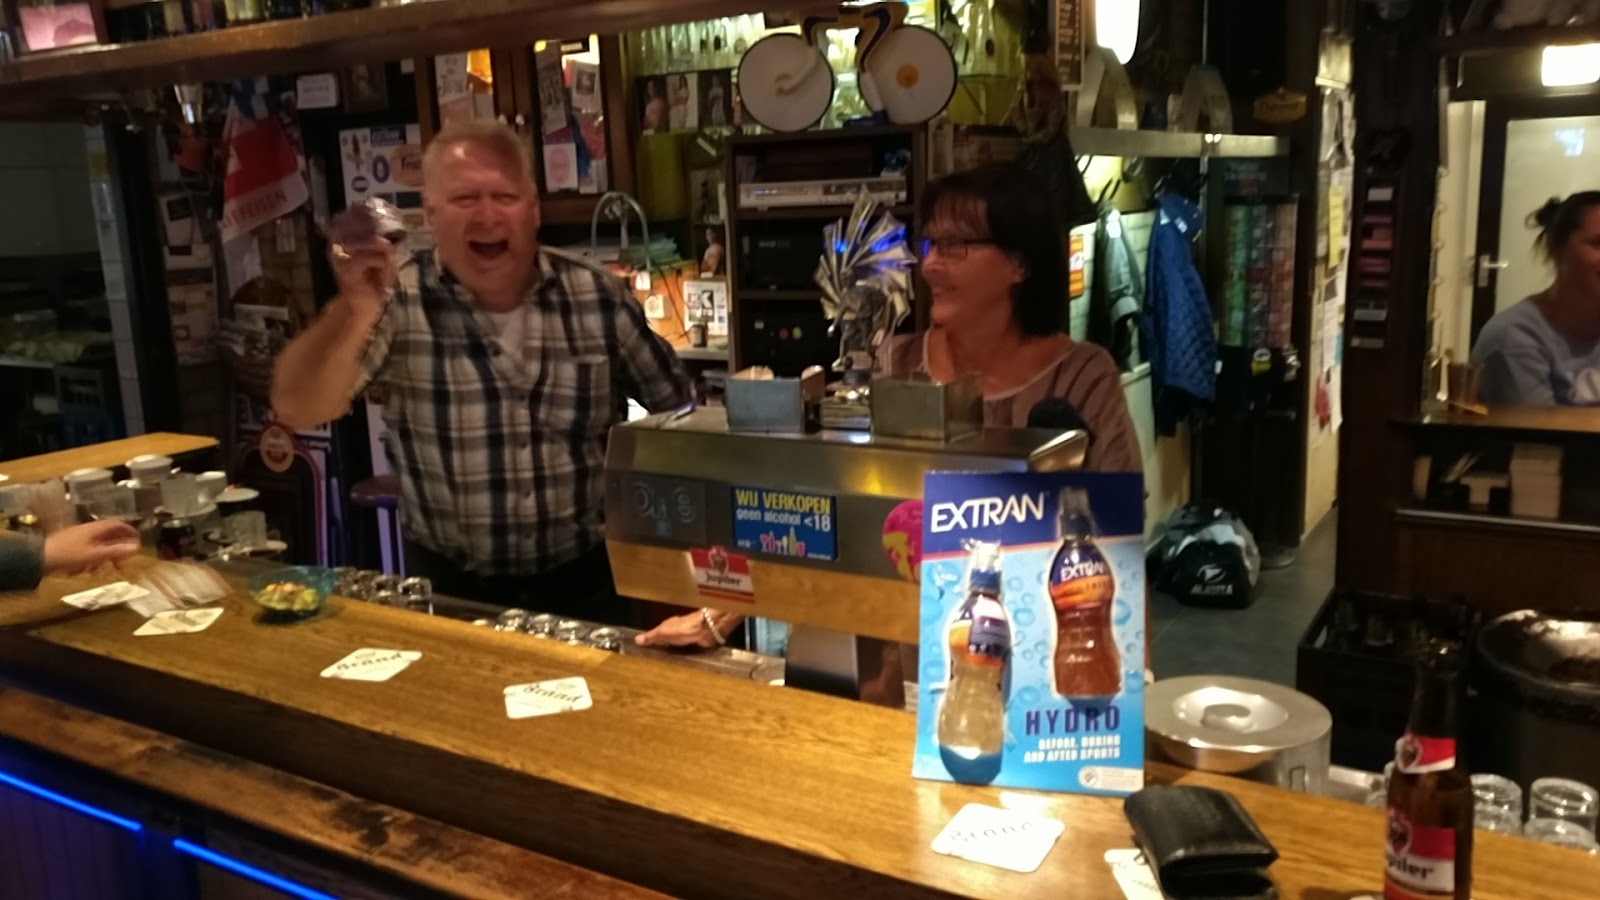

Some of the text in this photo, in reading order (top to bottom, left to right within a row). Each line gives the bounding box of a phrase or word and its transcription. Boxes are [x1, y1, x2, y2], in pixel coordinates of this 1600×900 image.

[735, 489, 830, 514] WIJ VERKOPEN
[736, 508, 831, 533] geen alcohol <18
[930, 492, 1045, 533] EXTRAN
[705, 571, 742, 586] Jupiler
[1060, 561, 1104, 582] EXTRAN
[336, 652, 403, 671] Brand
[523, 684, 584, 703] Brand
[1025, 705, 1120, 735] HYDRO
[1039, 734, 1121, 750] BEFORE, DURING
[1023, 746, 1121, 763] AND AFTER SPORTS
